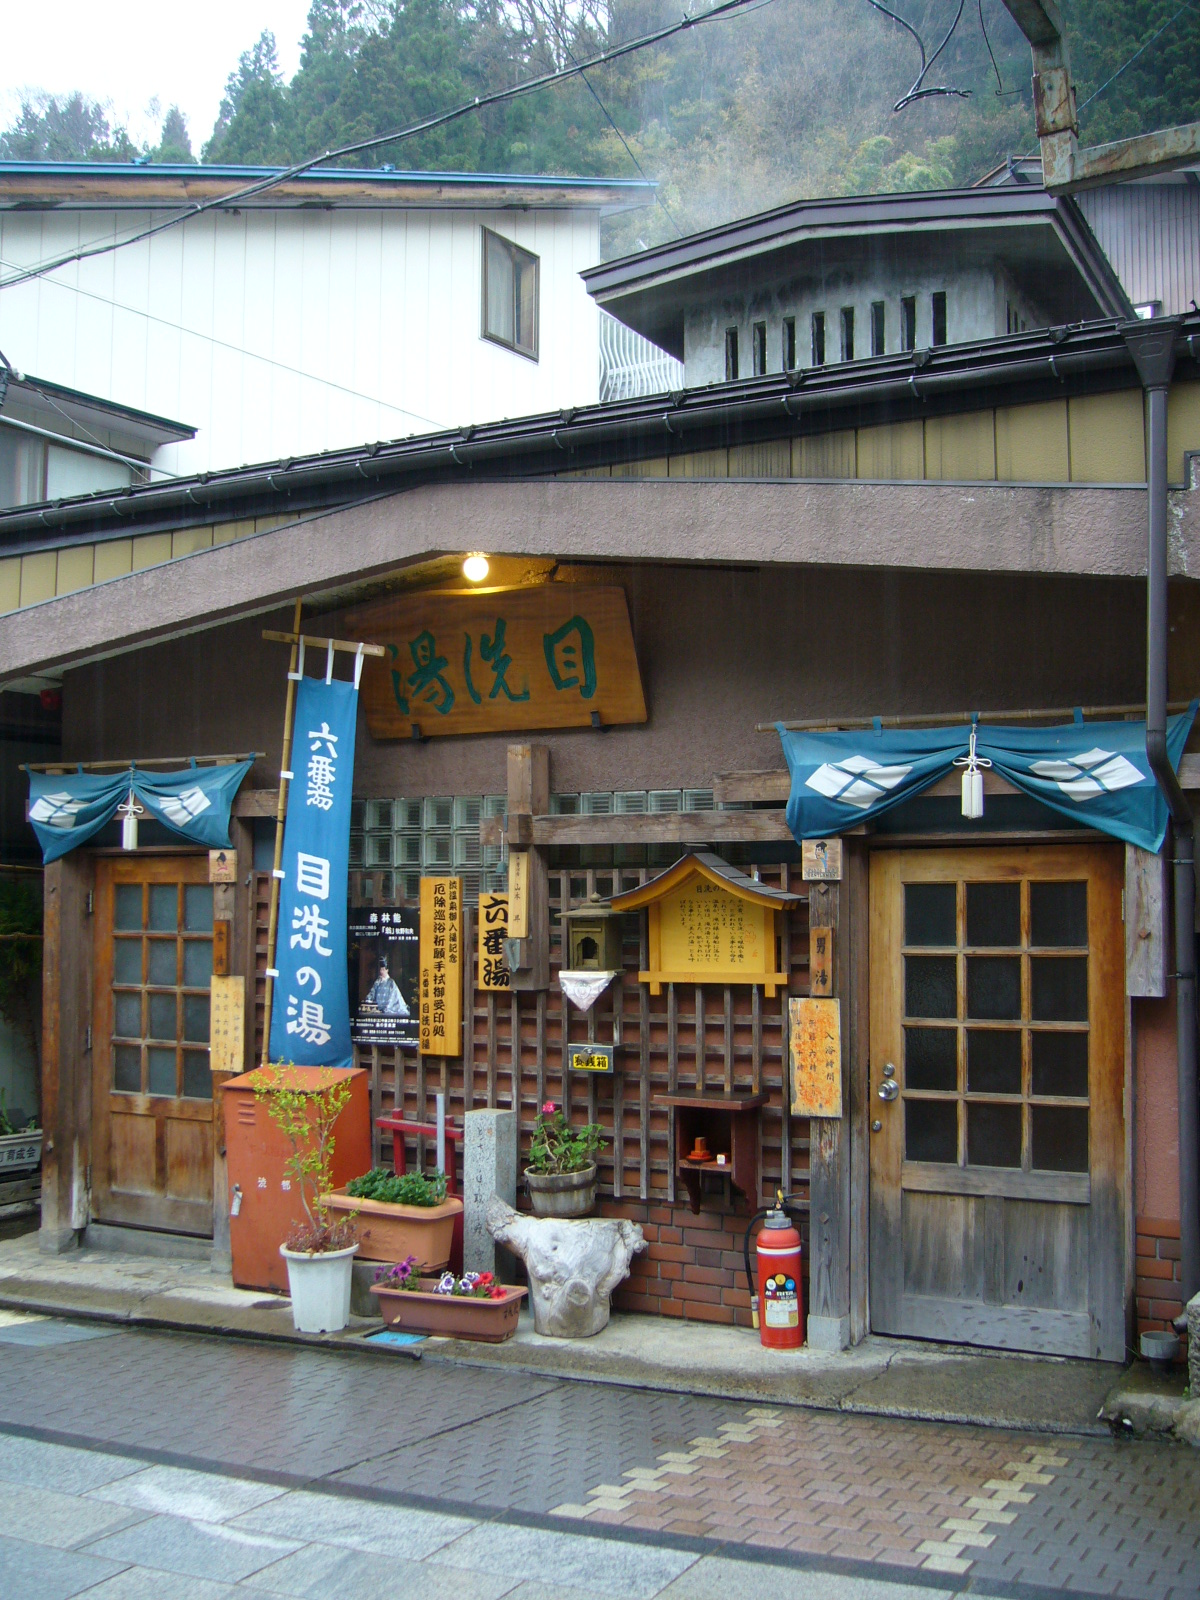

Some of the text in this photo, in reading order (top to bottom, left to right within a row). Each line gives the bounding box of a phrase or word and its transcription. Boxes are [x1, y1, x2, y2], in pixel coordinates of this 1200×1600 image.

[388, 615, 597, 715] 目洗湯
[307, 721, 338, 811] 六番湯
[286, 851, 333, 1046] 目洗の湯
[482, 895, 510, 987] 六番湯
[815, 937, 828, 986] 男湯
[824, 1031, 836, 1082] 入浴時間
